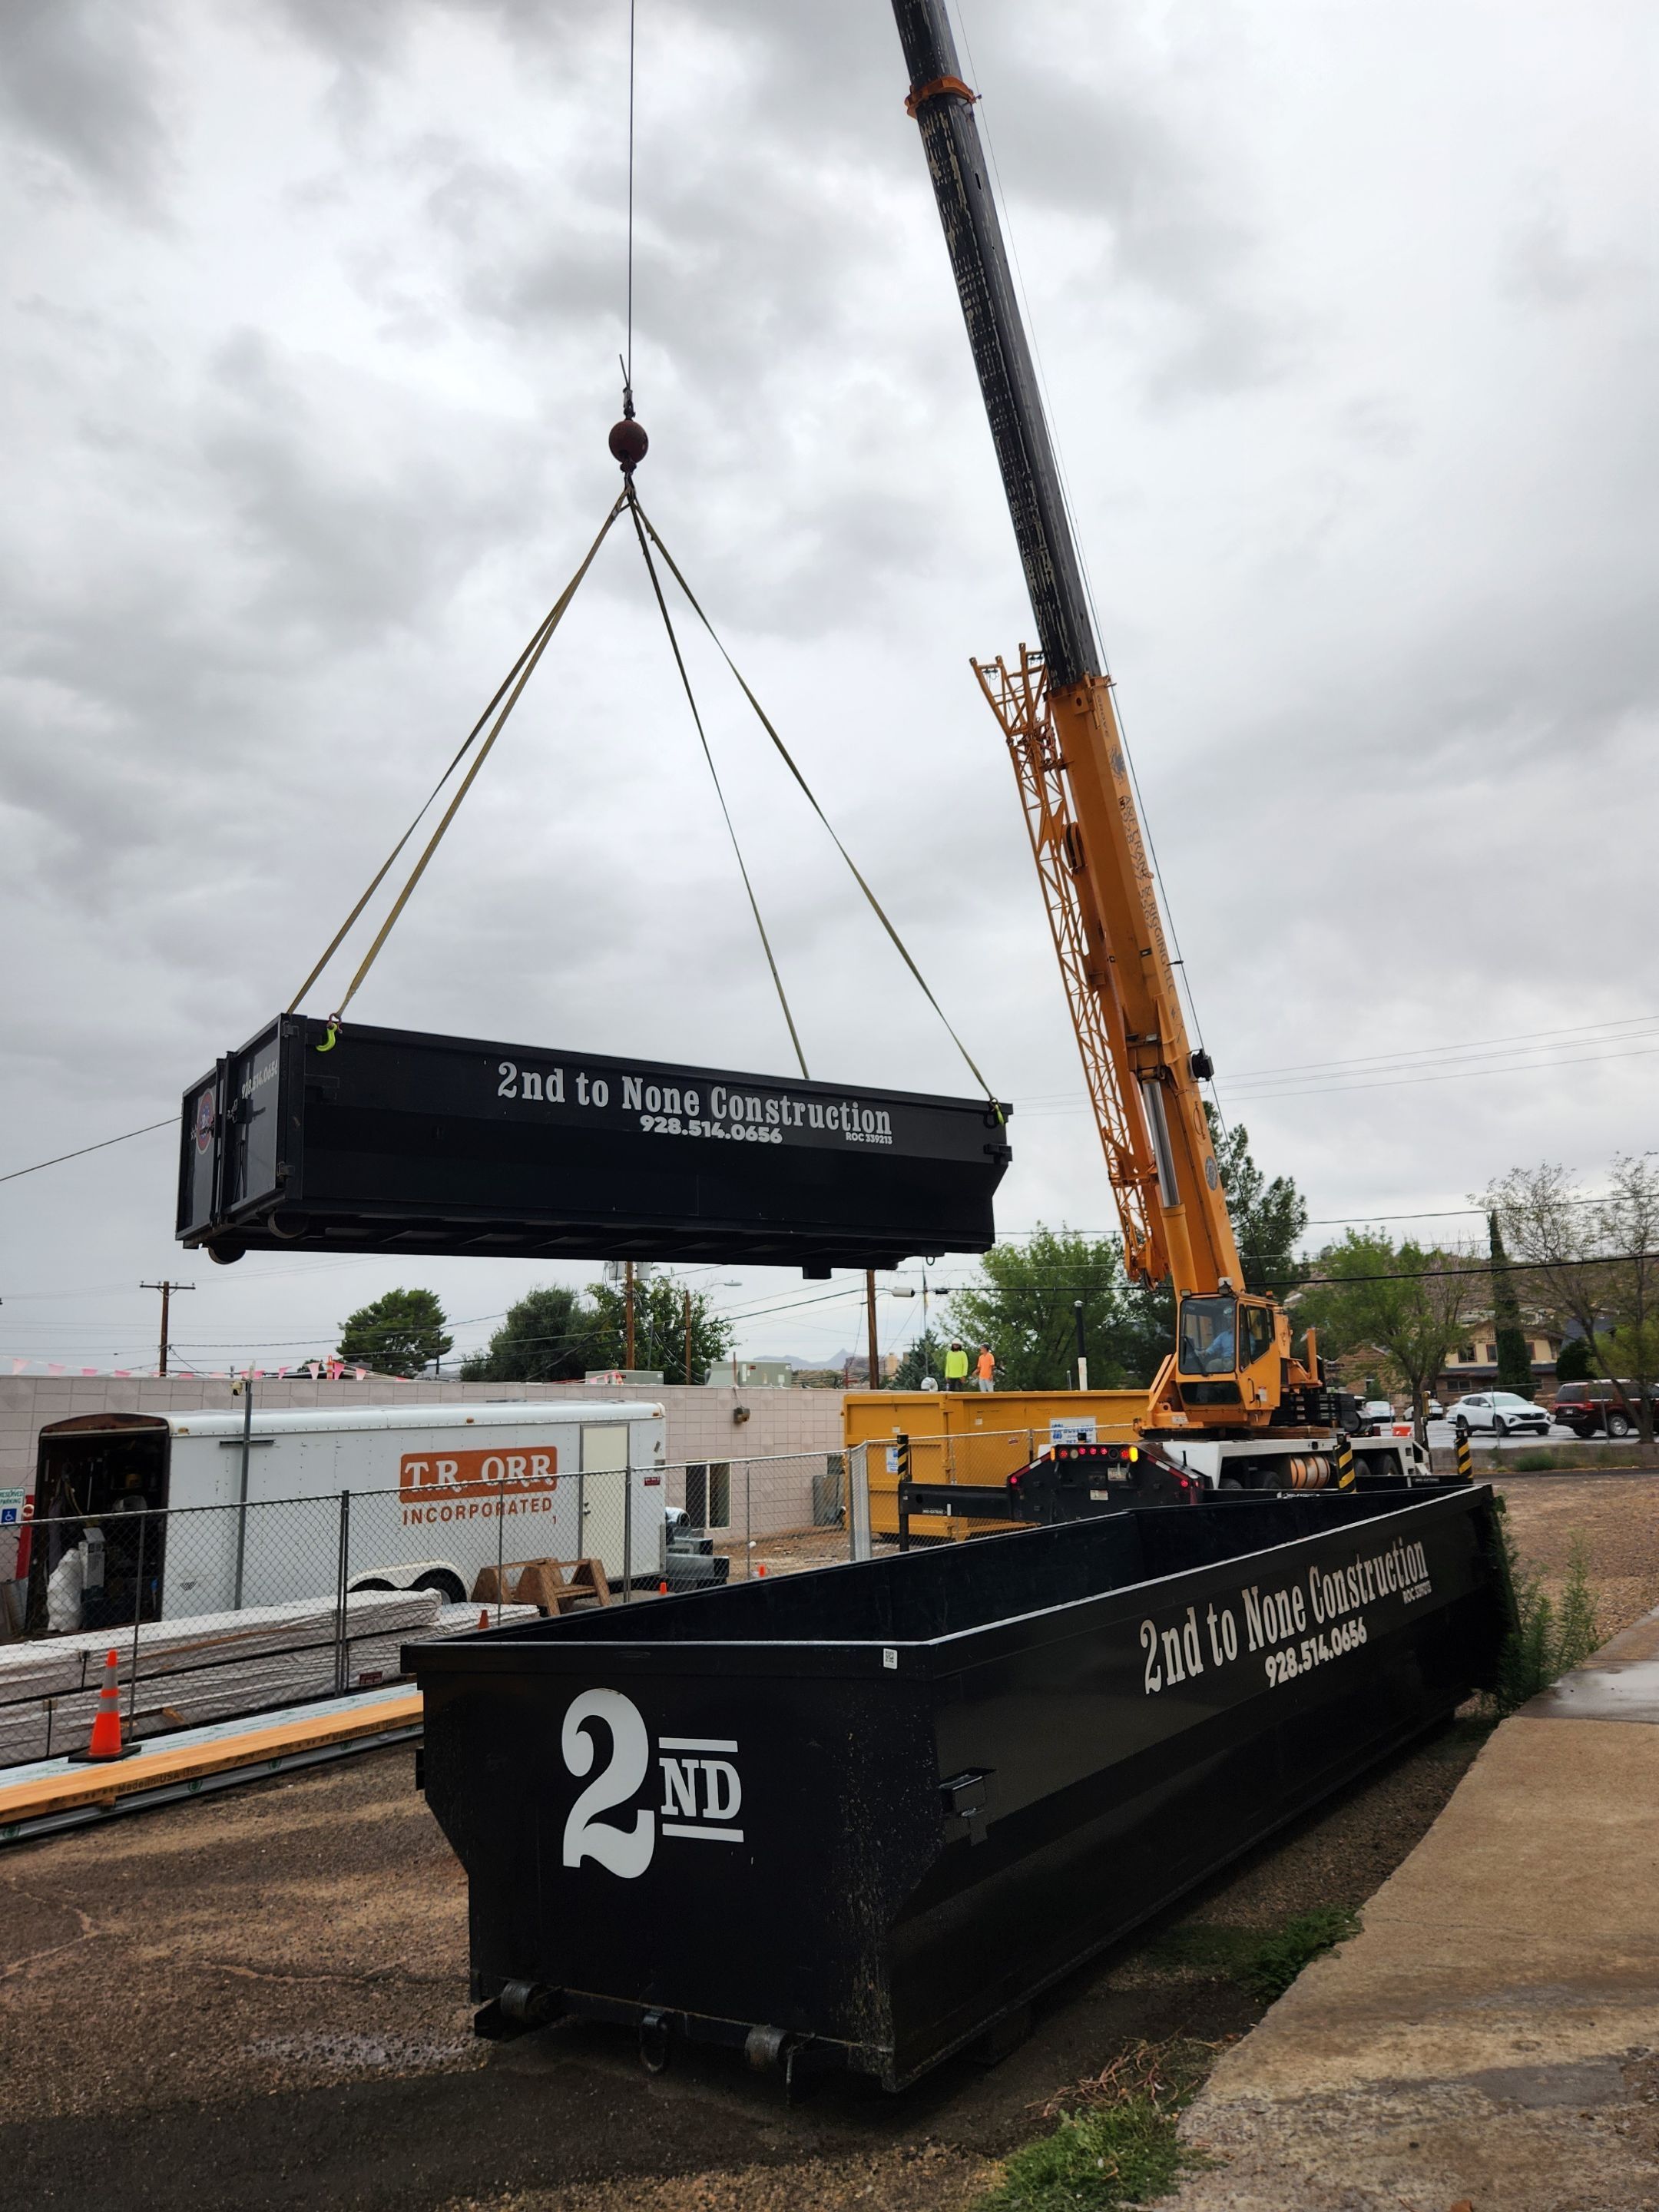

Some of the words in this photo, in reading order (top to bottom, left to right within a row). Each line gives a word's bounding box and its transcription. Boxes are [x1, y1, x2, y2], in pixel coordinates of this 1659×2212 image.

[1148, 902, 1169, 965] RIGGING
[498, 1061, 565, 1103] 2nd
[575, 1071, 609, 1108] to
[621, 1075, 700, 1117] None
[710, 1086, 892, 1135] Construction
[640, 1114, 783, 1144] 928.514.0656
[845, 1131, 865, 1142] ROC
[865, 1133, 892, 1144] 339213
[405, 1459, 469, 1492] T.R.
[481, 1454, 555, 1488] ORR
[402, 1497, 552, 1525] INCORPORATED
[1140, 1606, 1204, 1695] 2nd
[1207, 1603, 1238, 1667] to
[1241, 1585, 1306, 1652] None
[1309, 1538, 1429, 1624] Construction
[1264, 1616, 1367, 1688] 928.514.0656
[160, 1771, 180, 1783] USA
